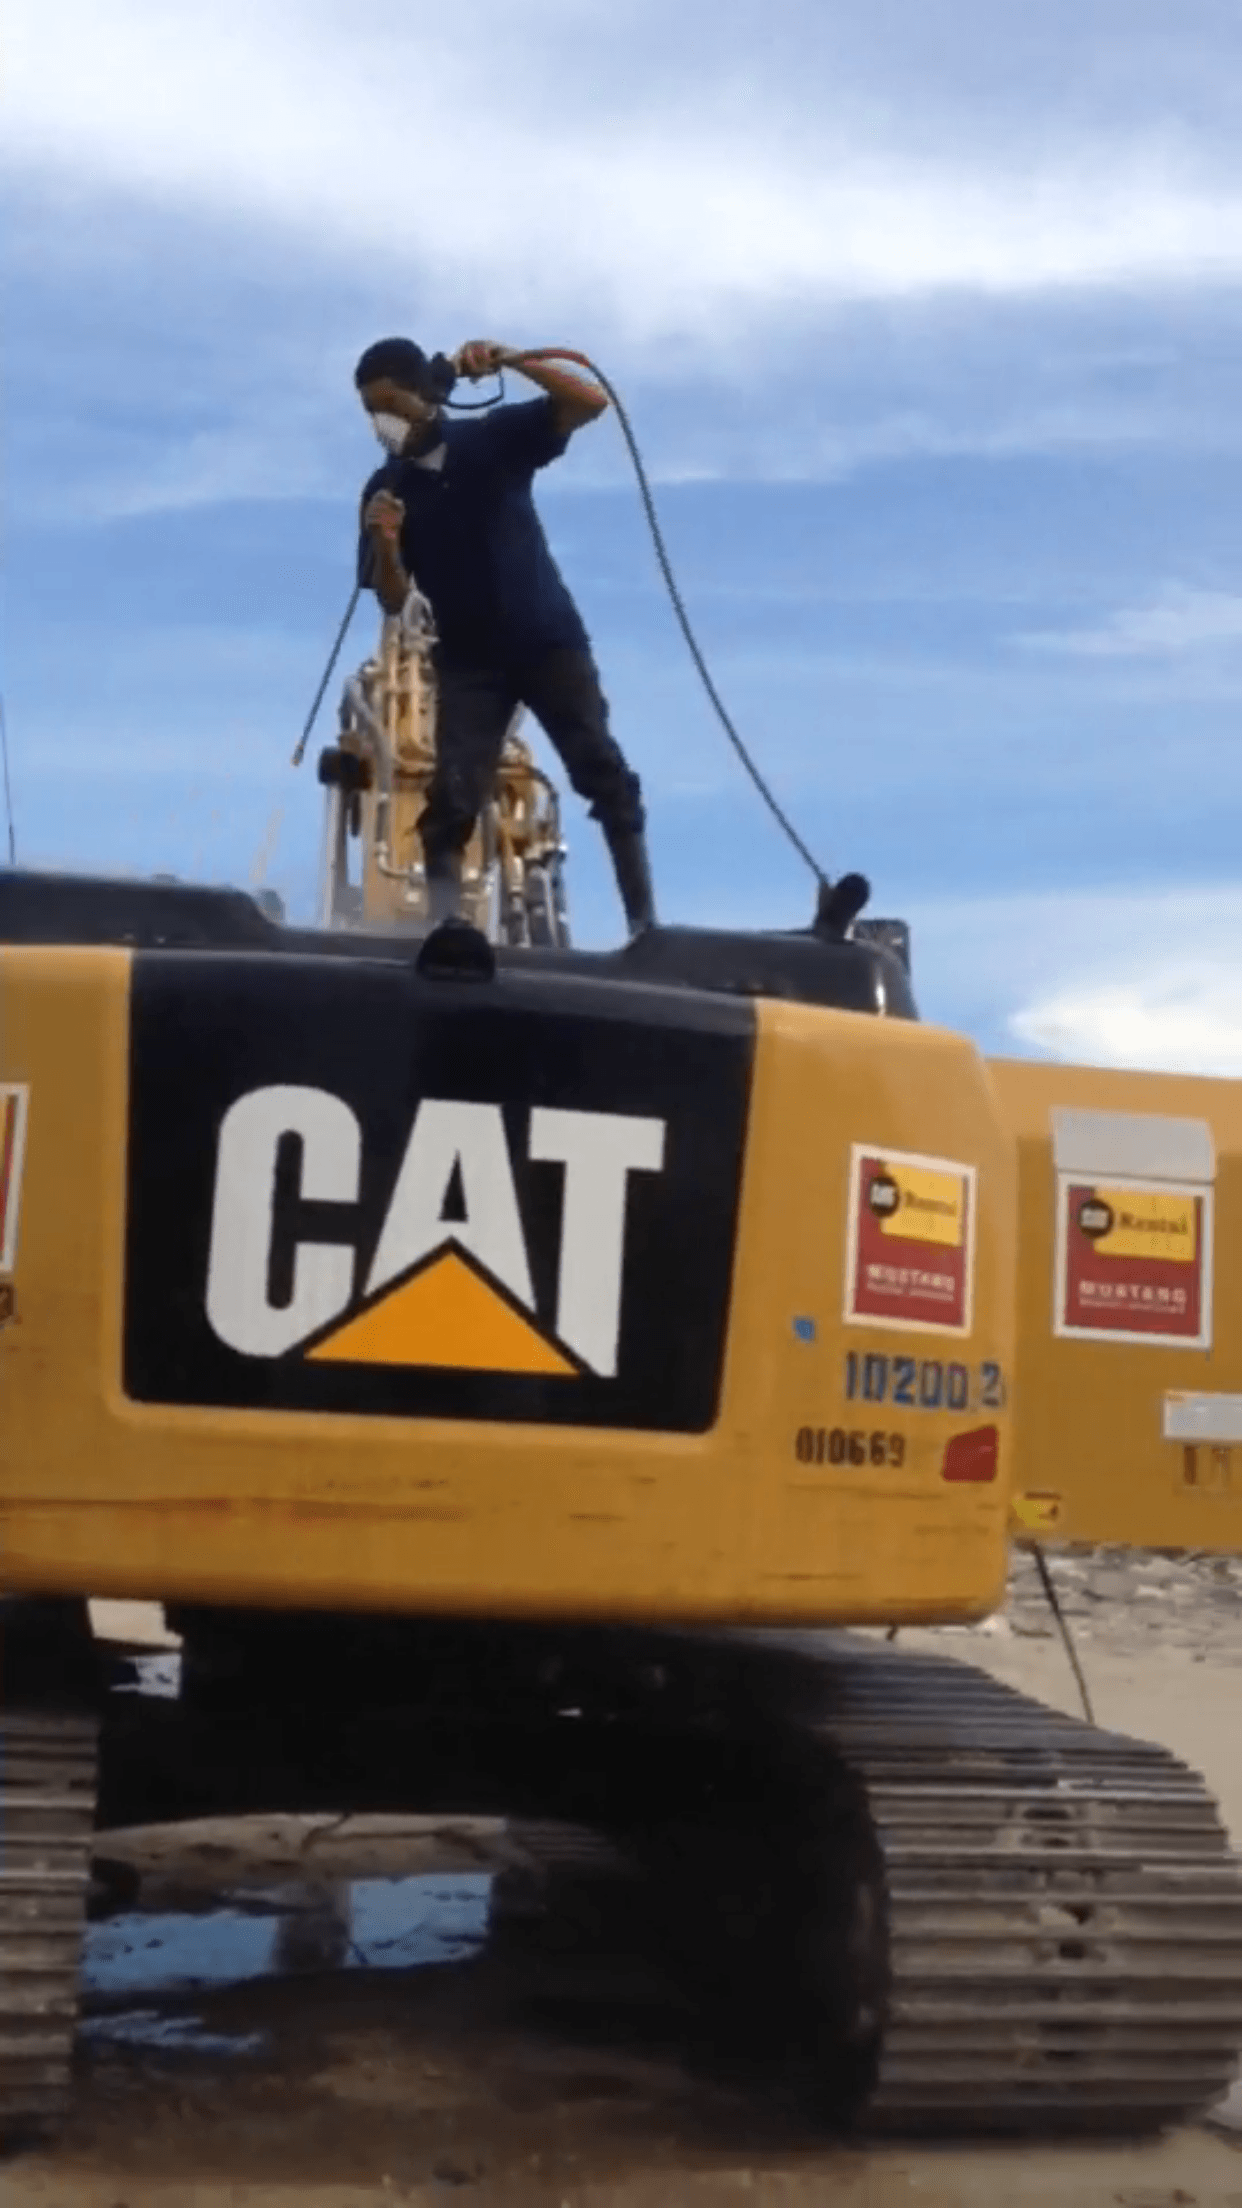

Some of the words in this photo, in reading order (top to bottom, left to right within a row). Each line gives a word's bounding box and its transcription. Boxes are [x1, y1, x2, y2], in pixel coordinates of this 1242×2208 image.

[206, 1085, 666, 1377] CAT
[1078, 1280, 1188, 1304] MUSTANG
[795, 1426, 906, 1468] 010669
